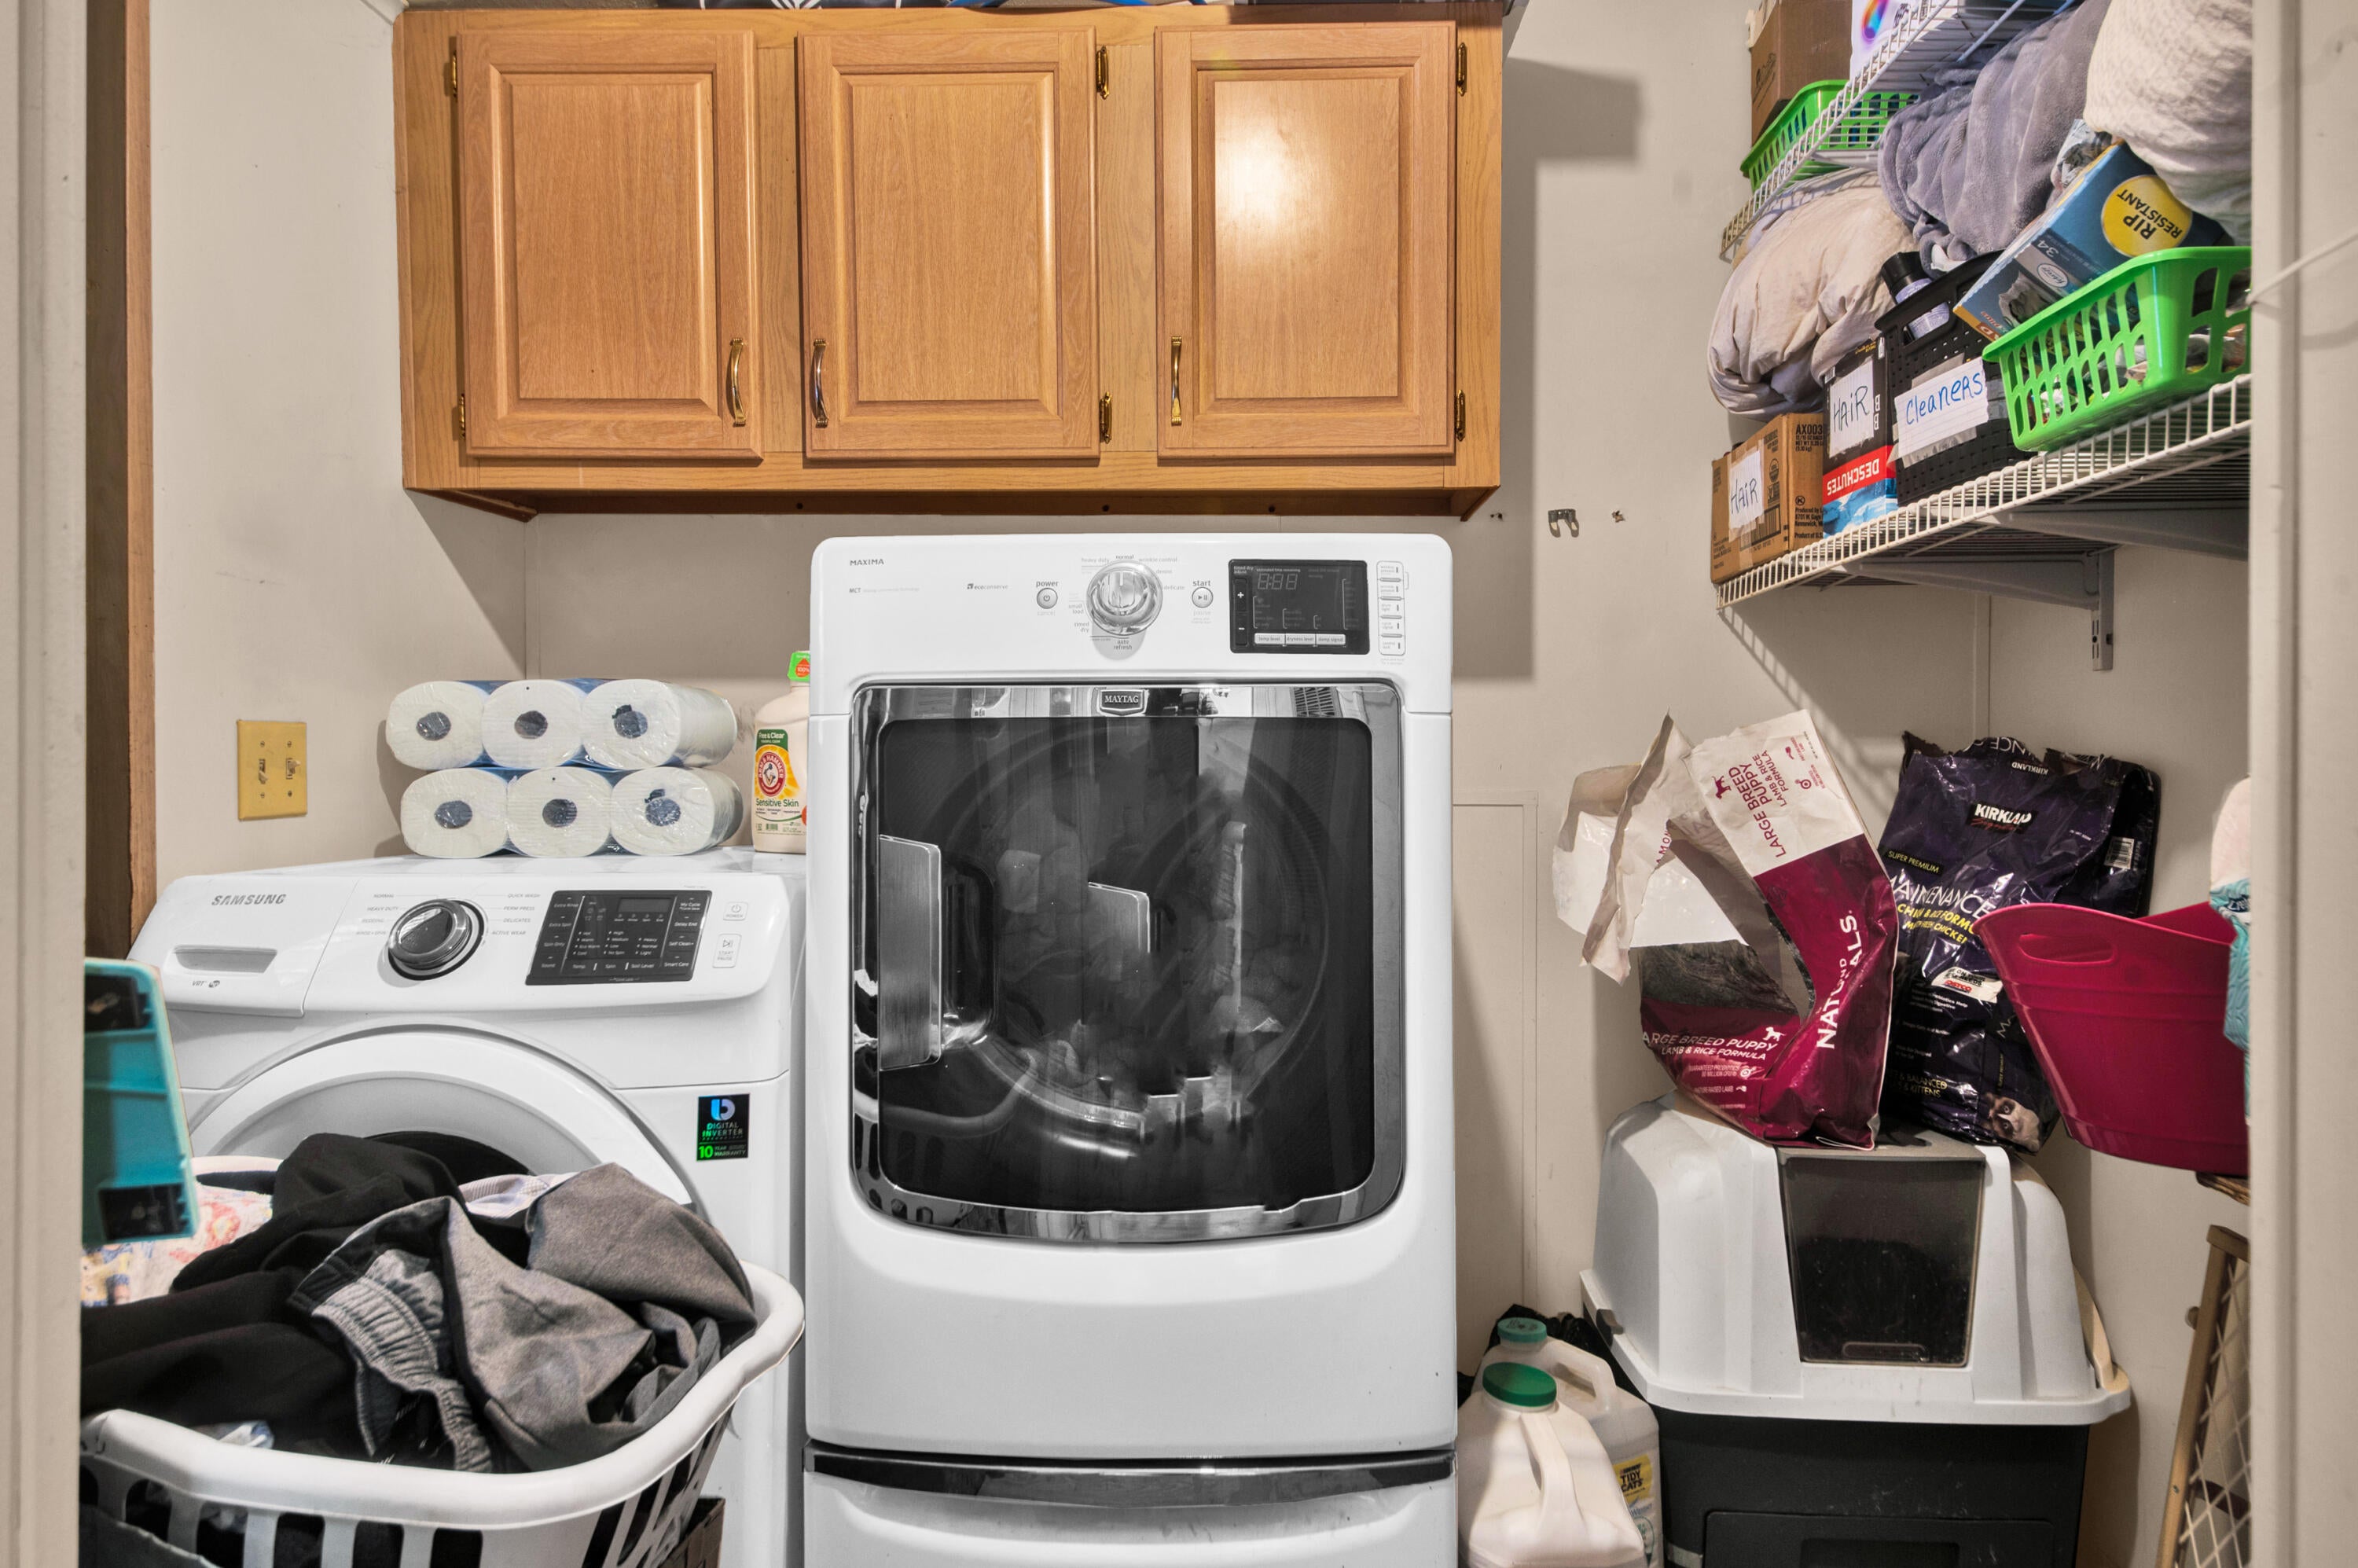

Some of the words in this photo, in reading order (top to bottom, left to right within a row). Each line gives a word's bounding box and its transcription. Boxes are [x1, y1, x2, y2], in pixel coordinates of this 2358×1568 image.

[2117, 189, 2183, 239] RESISTANT
[2123, 215, 2157, 240] RIP
[2037, 240, 2059, 257] 34
[1827, 458, 1879, 496] DESCHUTES
[1104, 694, 1139, 705] MAYTAG
[1752, 754, 1768, 775] RICE
[1761, 750, 1789, 792] FORMULA
[2011, 762, 2048, 775] KIRKLAND
[1728, 766, 1760, 810] BREED
[1739, 763, 1772, 806] PUPPY
[783, 799, 799, 807] Skin
[1769, 782, 1787, 807] LAMB
[1754, 810, 1787, 857] LARGE
[1889, 851, 1908, 862] SUPER
[1908, 857, 1939, 873] PREMIUM
[211, 894, 287, 906] SAMSUNG
[1643, 1031, 1678, 1045] ARGE
[1679, 1036, 1725, 1046] BREED
[1726, 1038, 1778, 1051] PUPPY
[1717, 1048, 1766, 1060] FORMULA
[1907, 1074, 1948, 1089] BALANCED
[1910, 1085, 1941, 1098] KITTENS
[702, 1129, 743, 1137] INVERTER
[699, 1145, 714, 1159] 10
[1621, 1470, 1641, 1484] TIDY
[1621, 1478, 1643, 1492] CATS
